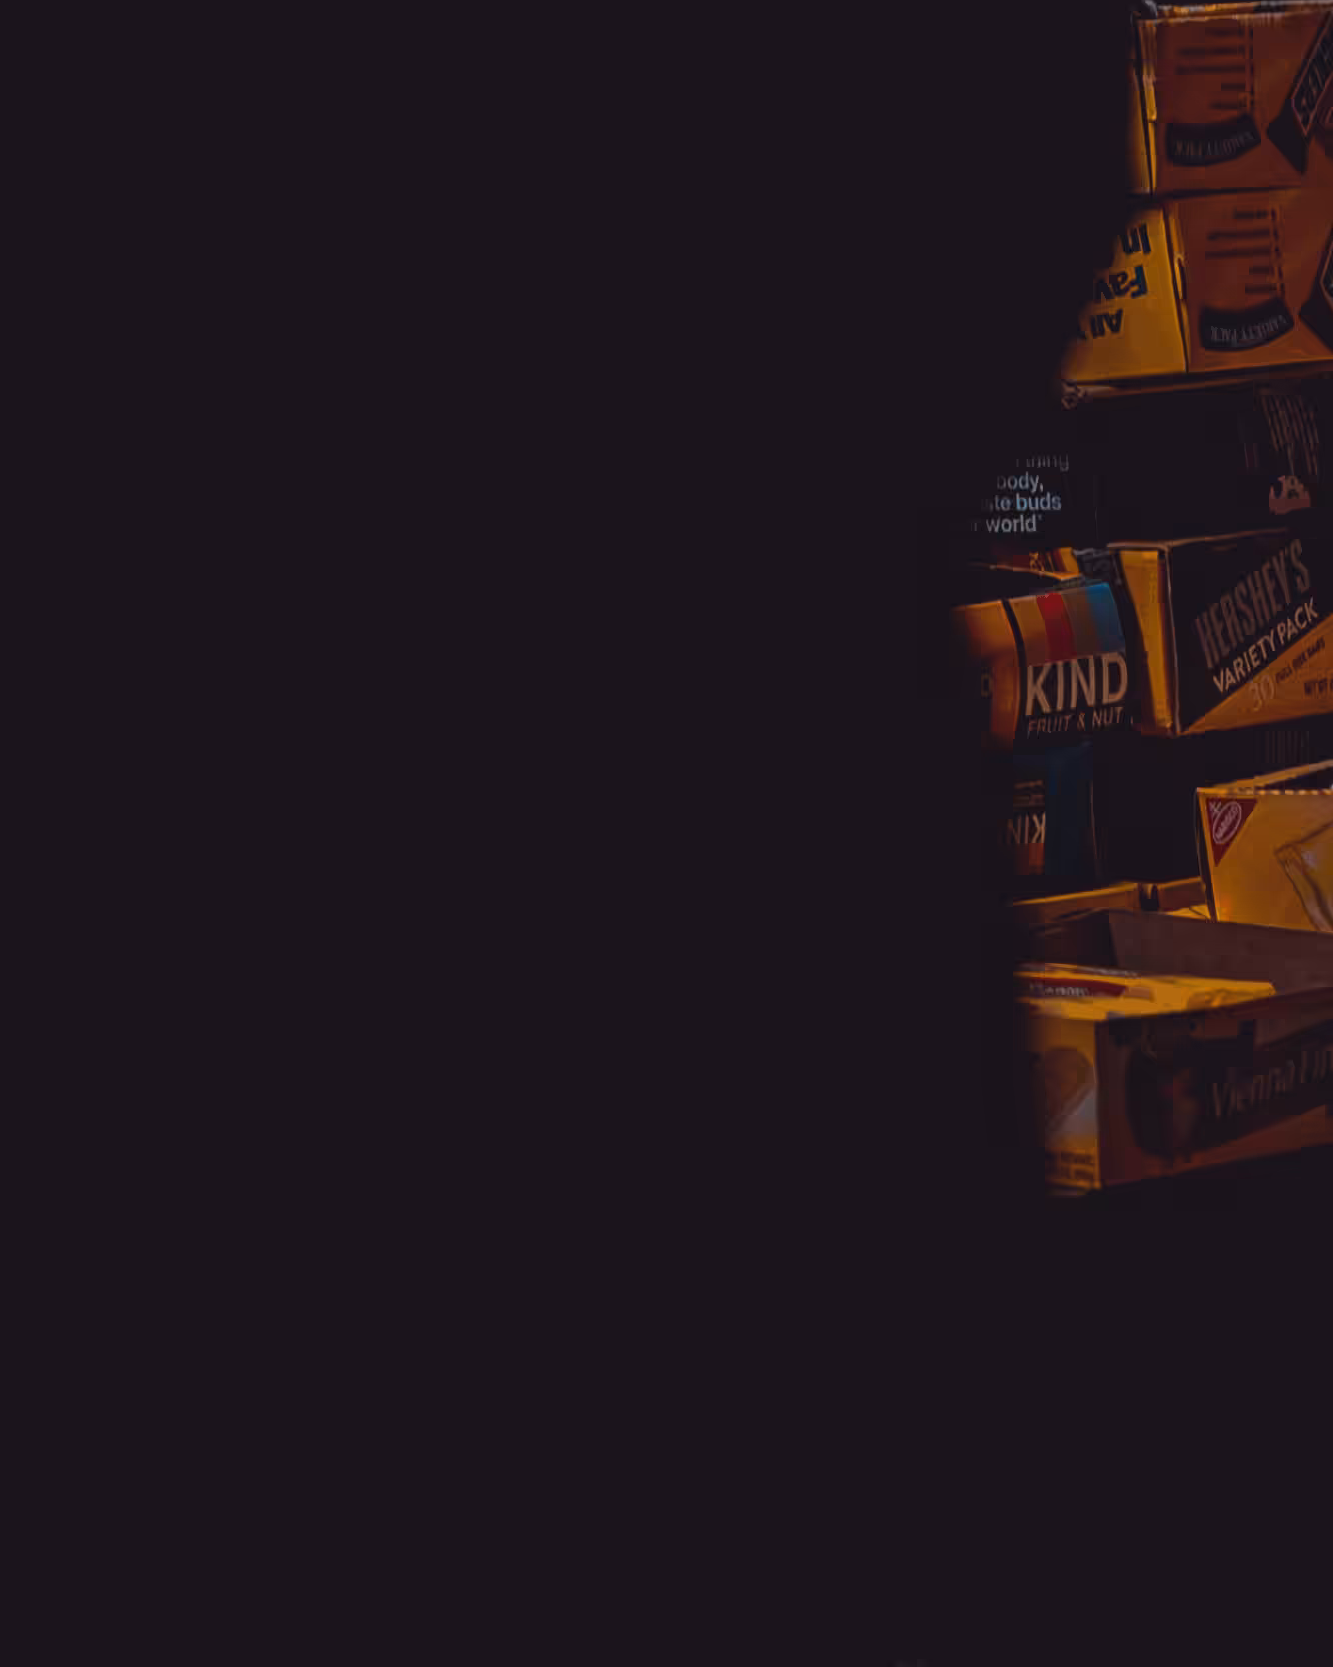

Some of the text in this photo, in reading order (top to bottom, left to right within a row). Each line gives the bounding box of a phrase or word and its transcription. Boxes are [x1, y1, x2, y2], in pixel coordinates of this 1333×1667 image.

[1095, 264, 1149, 304] Fav
[1015, 491, 1062, 512] buds
[1212, 628, 1276, 694] VARIETY
[1276, 596, 1318, 646] PACK
[1025, 652, 1128, 717] KIND
[1027, 706, 1125, 736] FRUIT & NUT
